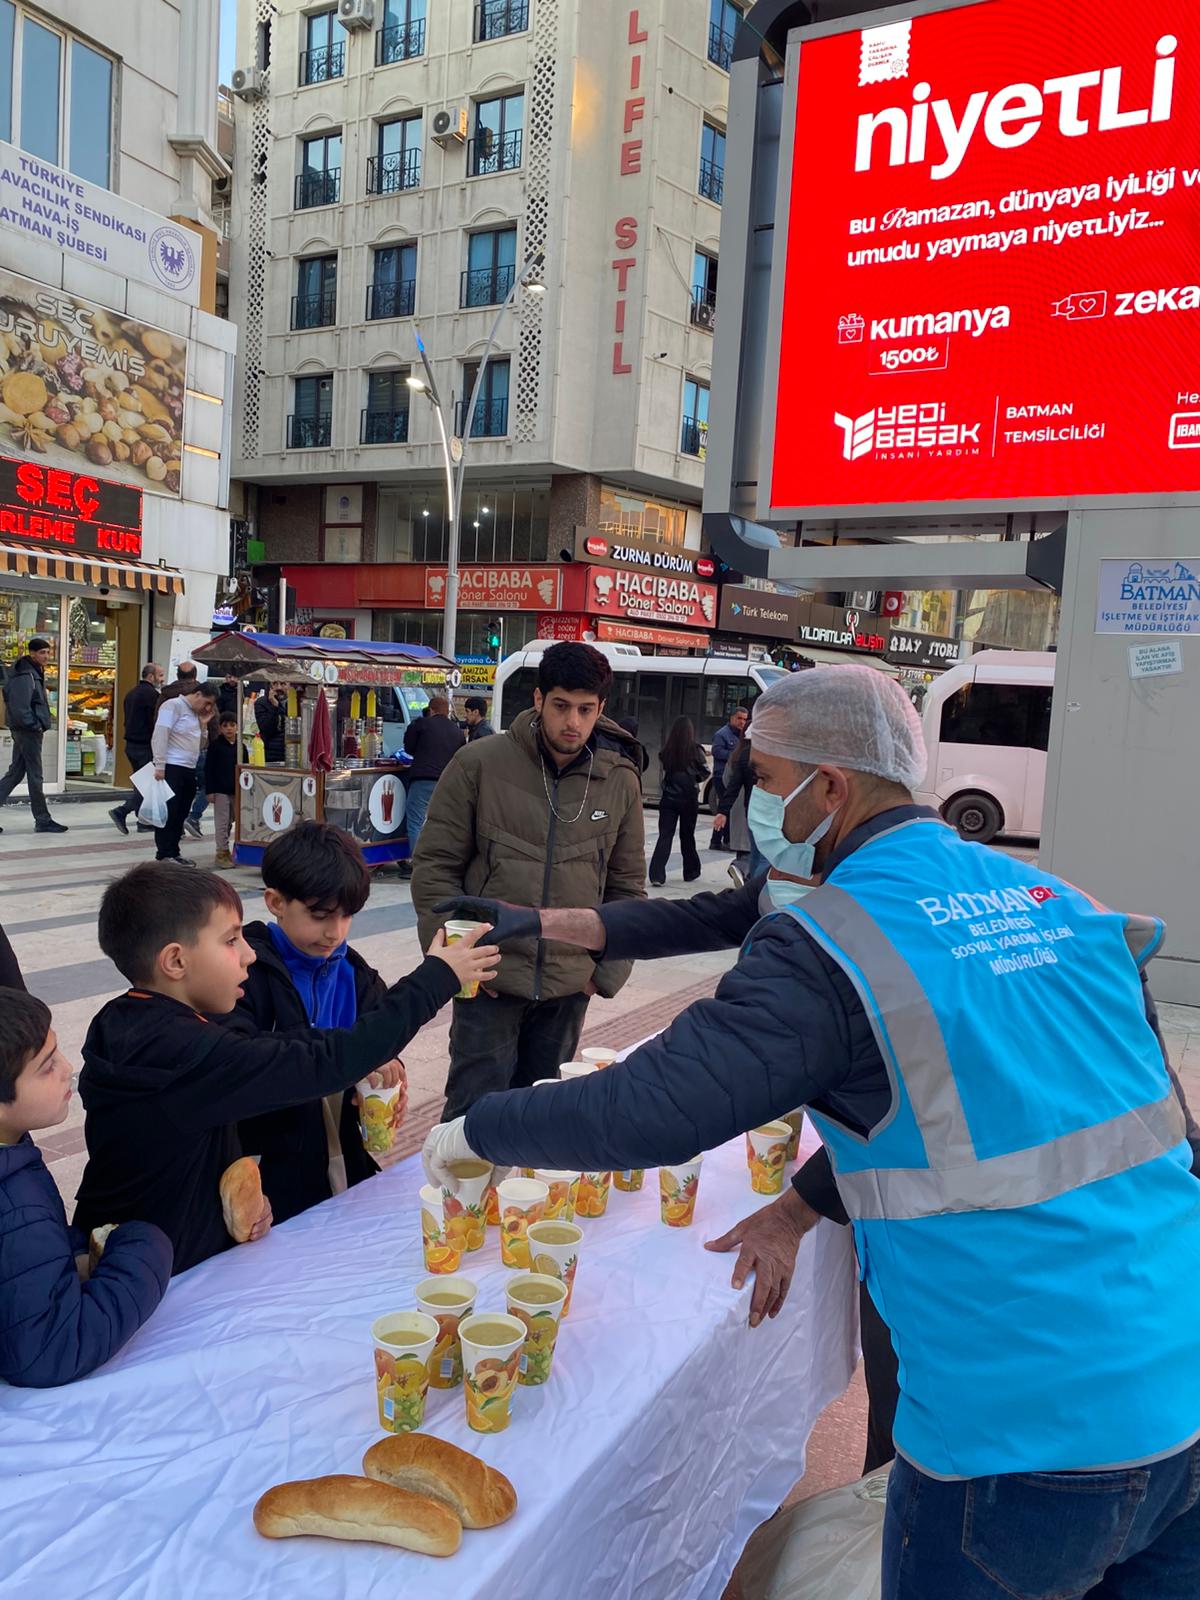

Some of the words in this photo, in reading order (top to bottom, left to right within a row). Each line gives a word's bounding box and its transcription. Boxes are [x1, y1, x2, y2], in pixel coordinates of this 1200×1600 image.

[620, 10, 648, 176] LIFE
[18, 156, 85, 199] TÜRKİYE
[0, 168, 70, 210] AVACILIK
[75, 202, 147, 243] SENDİKASI
[880, 198, 996, 231] Ramazan,
[999, 183, 1101, 215] dünyaya
[1182, 168, 1200, 187] v
[22, 196, 80, 234] HAVA-İŞ
[0, 206, 52, 239] ATMAN
[57, 231, 108, 262] ŞUBESİ
[847, 240, 920, 267] umudu
[926, 226, 1027, 262] yaymaya
[36, 292, 95, 333] SEÇ
[1006, 403, 1074, 420] BATMAN
[1004, 422, 1105, 443] TEMSİLCİLİĞİ
[928, 447, 980, 458] YARDIM
[16, 463, 99, 520] SEÇ
[0, 510, 75, 544] RLEME
[613, 545, 651, 566] ZURNA
[654, 552, 693, 573] DÜRÜM
[448, 571, 533, 588] ACIBABA
[615, 572, 700, 603] HACIBABA
[1120, 583, 1200, 600] BATMAN
[489, 588, 528, 601] Salonu
[620, 593, 655, 610] Döner
[658, 598, 695, 616] Salonu
[1132, 601, 1188, 611] BELEDİYESİ
[742, 605, 759, 617] Türk
[761, 608, 789, 621] Telekom
[1101, 611, 1142, 622] İŞLETME
[1145, 613, 1157, 621] VE
[1124, 622, 1191, 632] MÜDÜRLÜĞÜ
[615, 627, 654, 640] HACIBABA
[899, 636, 922, 654] BAY
[928, 641, 959, 658] STORE
[916, 885, 1042, 926] BATMAN
[951, 939, 996, 960] SOSYAL
[994, 931, 1042, 950] YARDIM
[1040, 924, 1075, 945] İŞLERİ
[989, 947, 1058, 976] MÜDÜRLÜĞÜ
